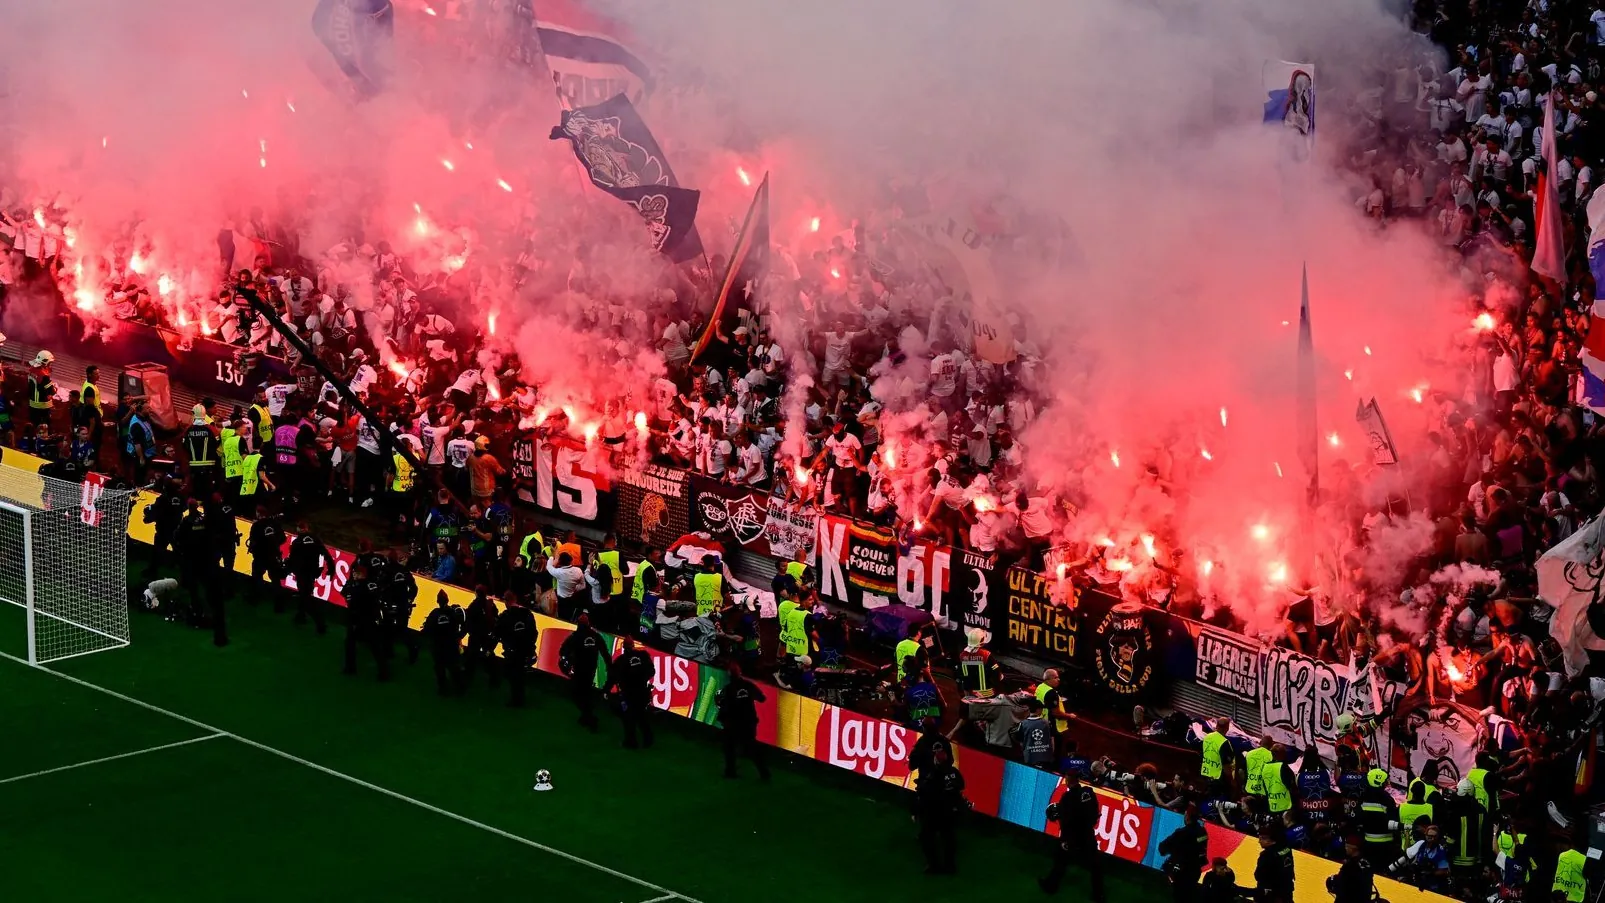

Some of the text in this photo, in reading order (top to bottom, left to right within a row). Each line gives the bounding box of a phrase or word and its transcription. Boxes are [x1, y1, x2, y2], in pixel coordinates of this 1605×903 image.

[216, 360, 244, 387] 130
[534, 438, 598, 522] IS
[624, 467, 682, 498] AMOUREUX
[849, 554, 896, 577] FOREVER
[963, 553, 996, 571] ULTRAS
[1008, 618, 1076, 657] ANTICO
[1197, 635, 1258, 678] LIBEREZ
[1139, 665, 1153, 687] SUD
[1195, 660, 1210, 681] LE
[1302, 800, 1329, 810] PHOTO
[1308, 811, 1325, 819] 274
